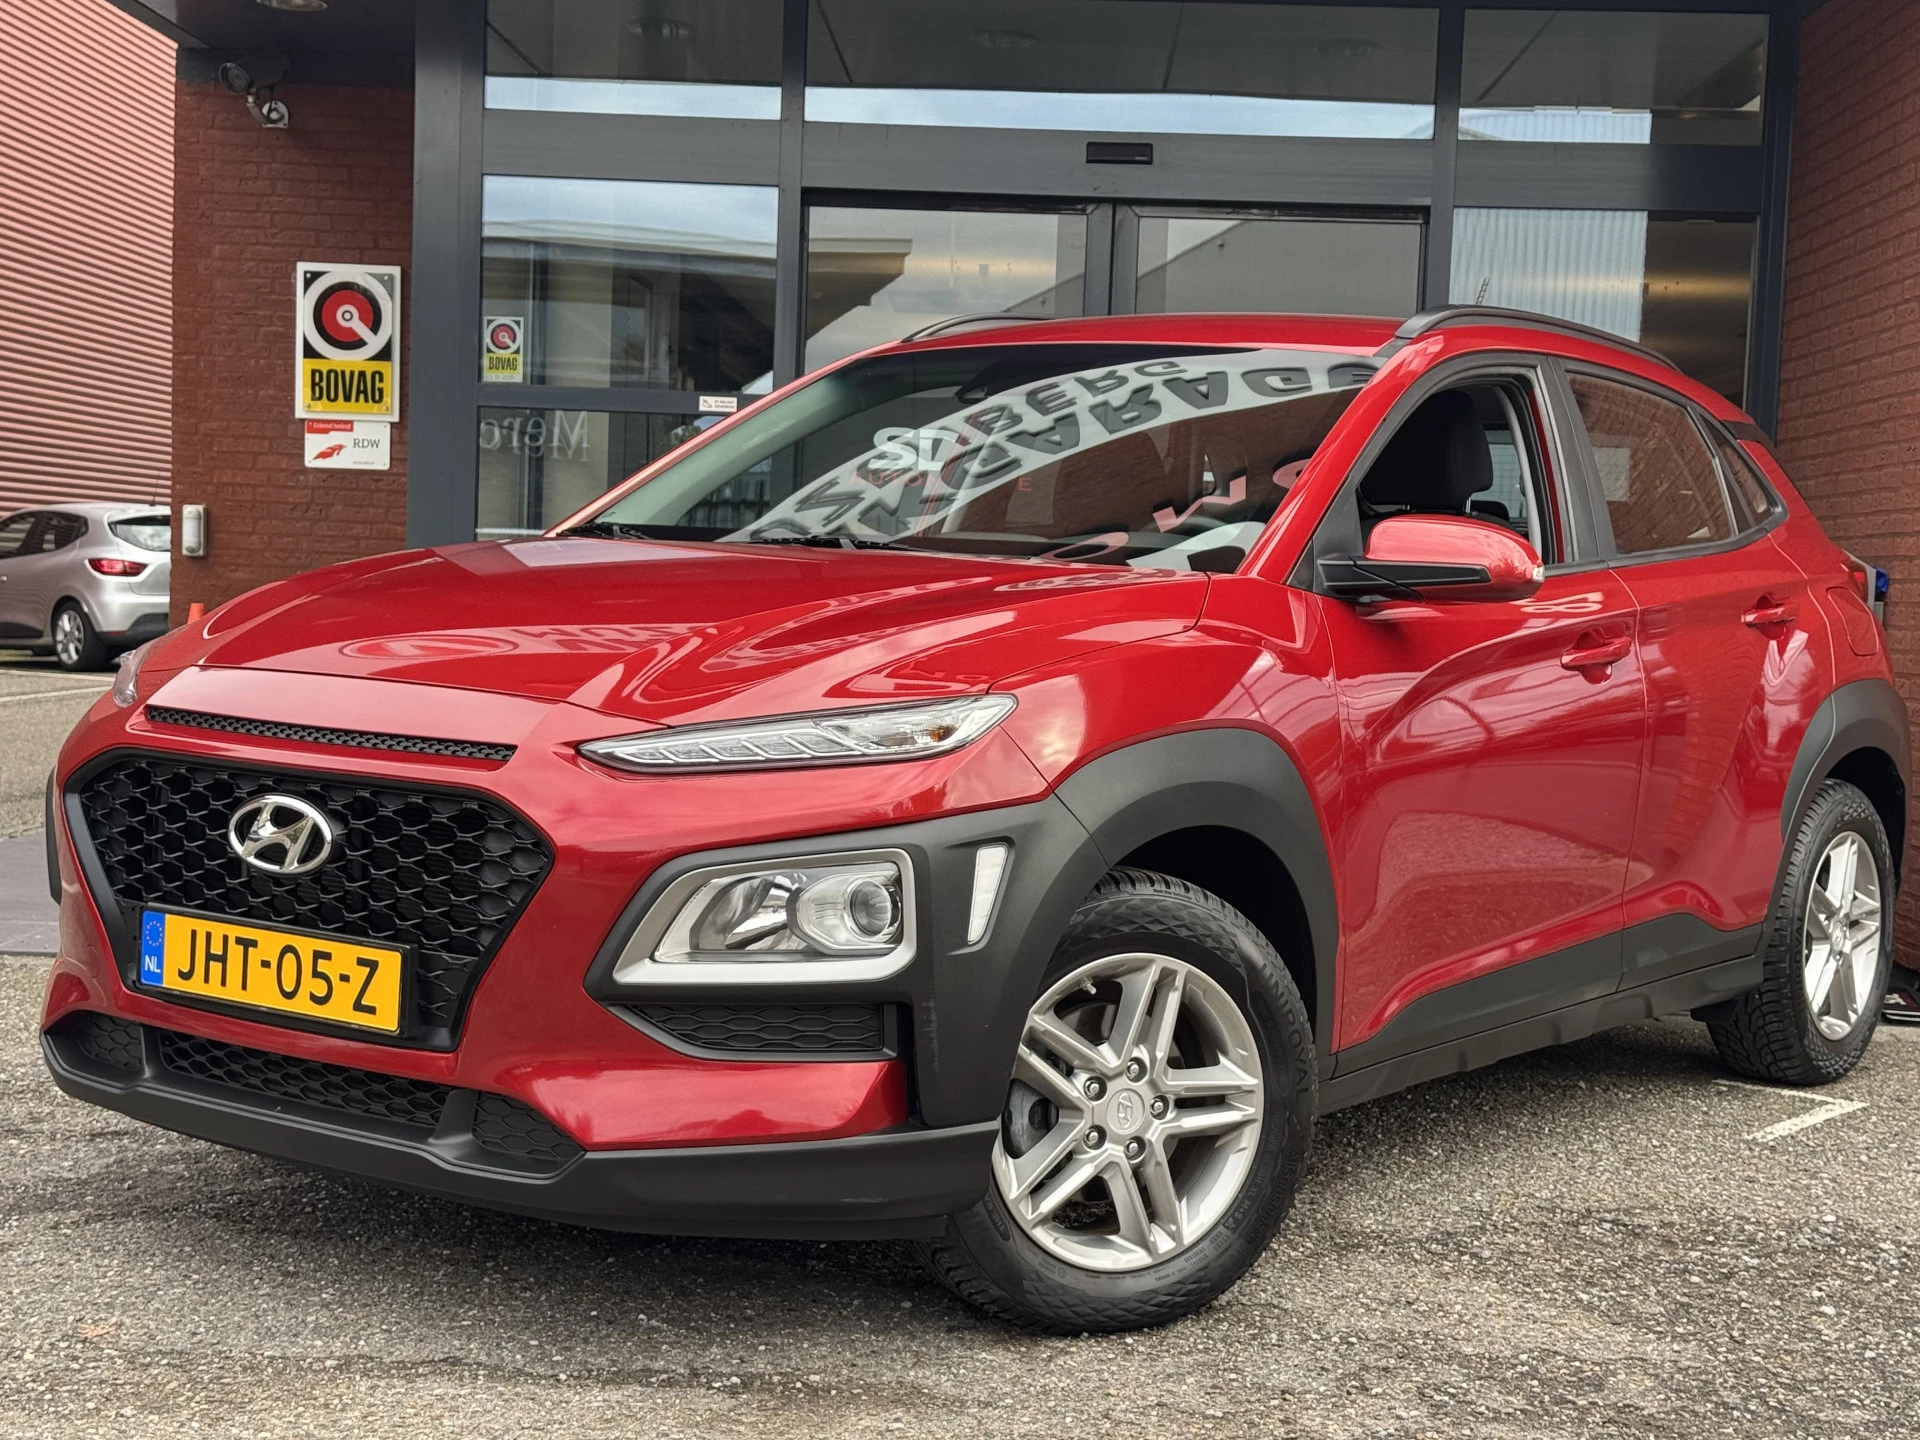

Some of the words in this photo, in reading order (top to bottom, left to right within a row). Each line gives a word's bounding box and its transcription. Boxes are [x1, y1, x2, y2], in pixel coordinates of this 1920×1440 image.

[489, 356, 518, 371] BOVAG
[310, 368, 385, 404] BOVAG
[353, 437, 381, 449] RDW
[144, 954, 161, 973] NL
[177, 928, 380, 1016] JHT-05-Z
[1254, 962, 1309, 1104] UNIROYAL
